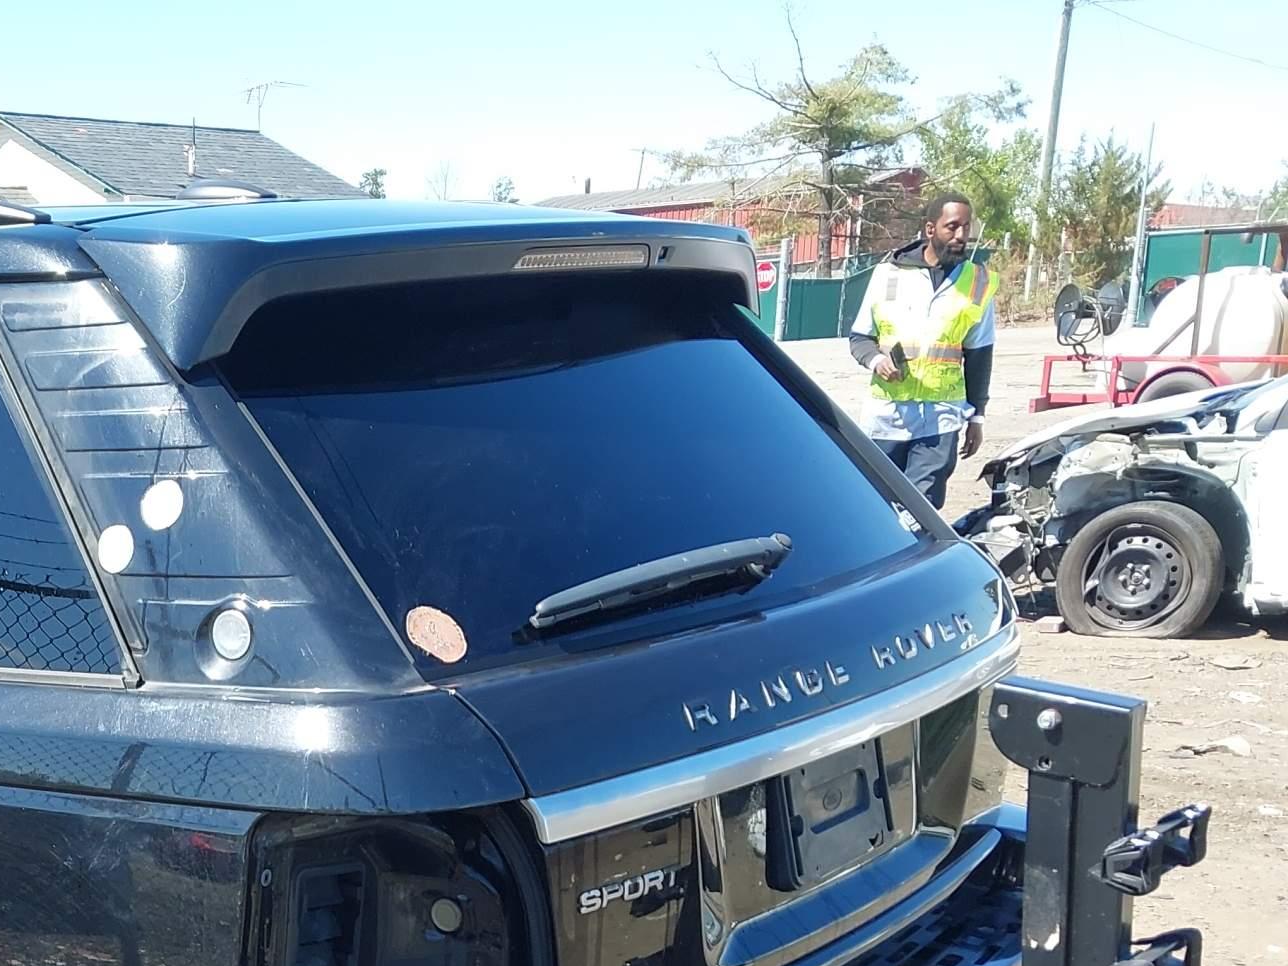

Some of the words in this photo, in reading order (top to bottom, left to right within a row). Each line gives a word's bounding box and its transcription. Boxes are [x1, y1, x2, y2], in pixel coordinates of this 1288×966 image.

[682, 660, 851, 731] RANGE
[872, 613, 973, 670] ROVER
[579, 869, 676, 915] SPORT
